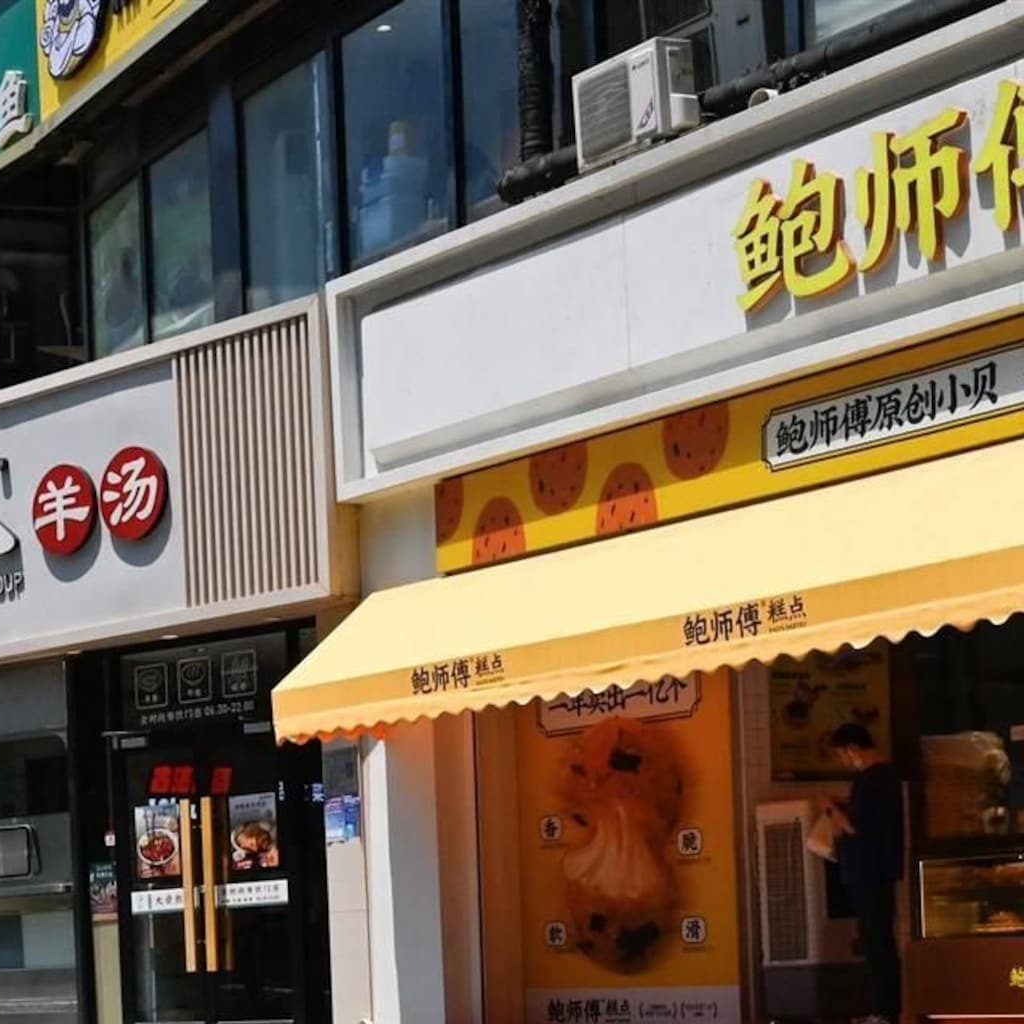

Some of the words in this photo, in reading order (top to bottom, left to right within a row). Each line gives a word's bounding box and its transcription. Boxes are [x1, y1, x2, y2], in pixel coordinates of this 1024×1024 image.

[775, 361, 998, 457] 鲍师傅原创小贝
[34, 456, 159, 541] 羊汤
[682, 603, 762, 646] 鲍师傅
[767, 595, 807, 623] 糕点
[411, 658, 471, 695] 鲍师傅
[475, 652, 505, 677] 糕点
[547, 999, 601, 1024] 鲍师傅
